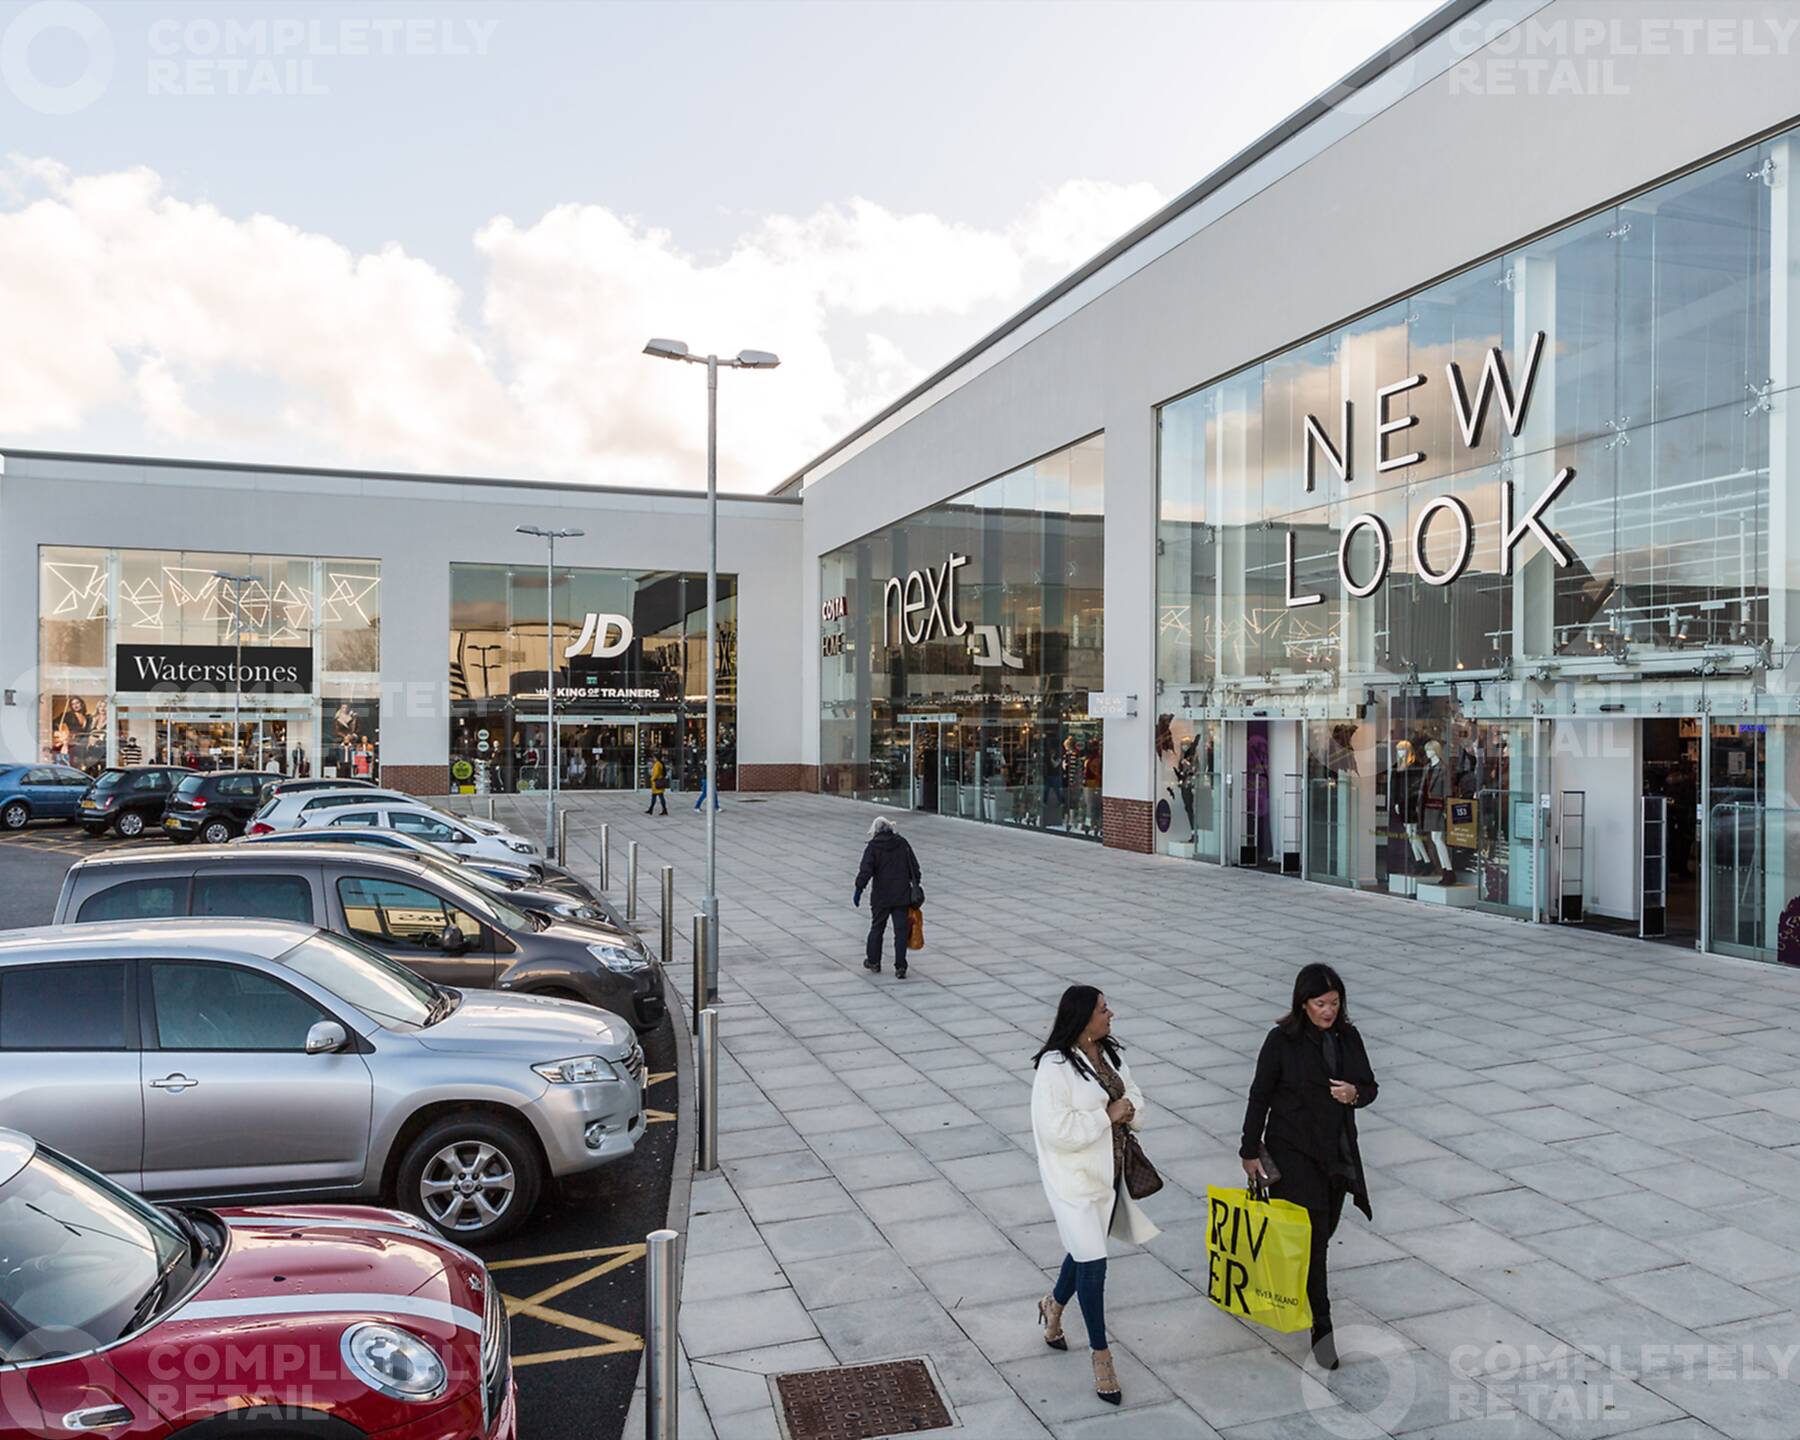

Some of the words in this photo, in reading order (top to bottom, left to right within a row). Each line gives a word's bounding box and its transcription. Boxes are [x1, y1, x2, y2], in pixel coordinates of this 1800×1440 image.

[1303, 331, 1547, 493] NEW
[1286, 467, 1577, 607] LOOK
[883, 552, 971, 648] next
[565, 613, 634, 658] JD
[133, 655, 298, 682] Waterstones
[556, 687, 587, 698] KING
[587, 687, 600, 697] OF
[600, 688, 660, 698] TRAINERS
[1211, 1198, 1268, 1262] RIV
[1208, 1250, 1251, 1315] ER
